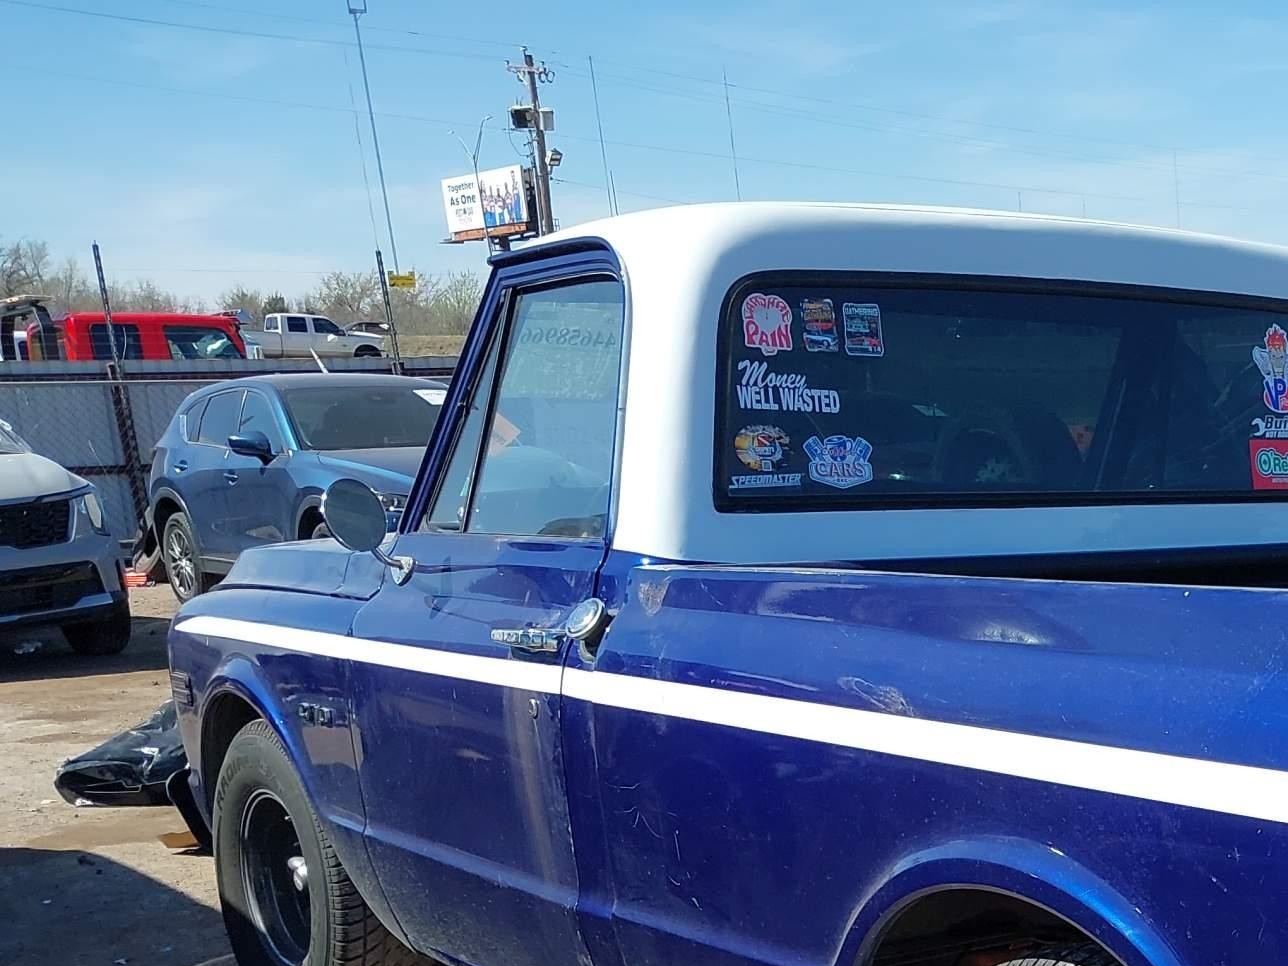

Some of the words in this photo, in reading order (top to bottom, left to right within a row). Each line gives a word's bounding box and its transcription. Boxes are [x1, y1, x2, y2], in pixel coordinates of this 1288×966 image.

[448, 182, 474, 193] Together
[450, 196, 460, 206] As
[461, 194, 476, 204] One
[738, 360, 807, 395] Money
[736, 385, 779, 410] WELL
[779, 387, 840, 413] WASTED
[1265, 378, 1287, 411] VP
[817, 461, 864, 477] CARS
[729, 473, 801, 488] SPEEDMASTER
